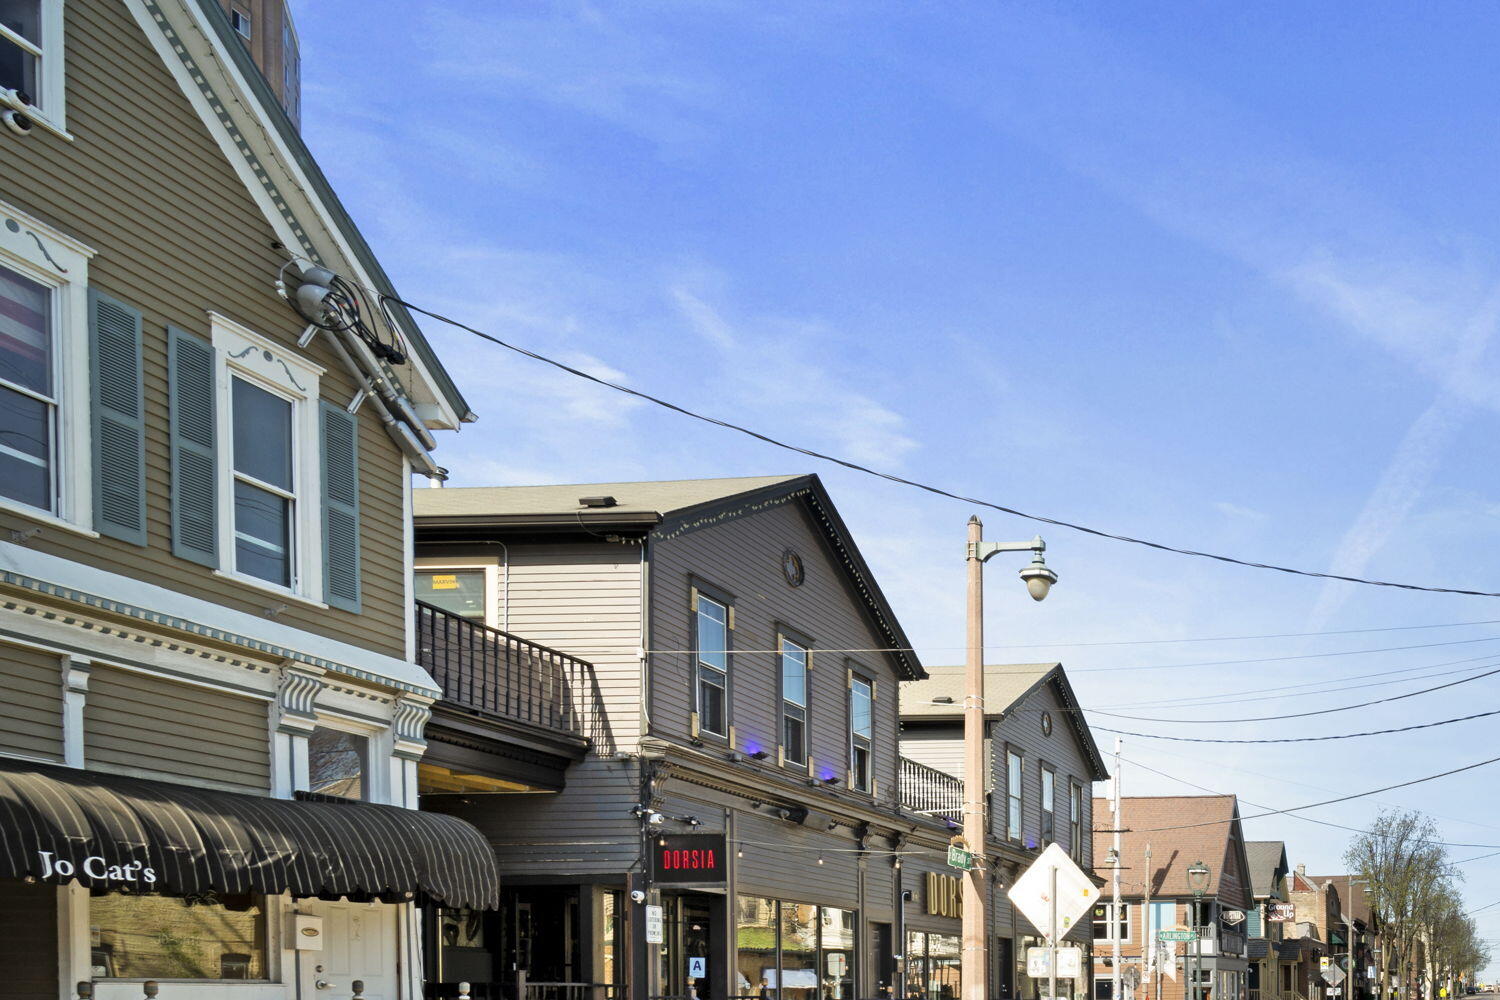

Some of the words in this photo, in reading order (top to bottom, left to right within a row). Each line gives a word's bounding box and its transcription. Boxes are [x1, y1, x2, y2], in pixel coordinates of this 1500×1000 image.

[38, 851, 74, 878] Jo
[83, 856, 156, 882] Cat's
[663, 850, 715, 869] DORSIA
[951, 849, 967, 867] Brady
[928, 871, 963, 918] DORS
[1283, 909, 1294, 919] Up
[693, 960, 702, 971] A
